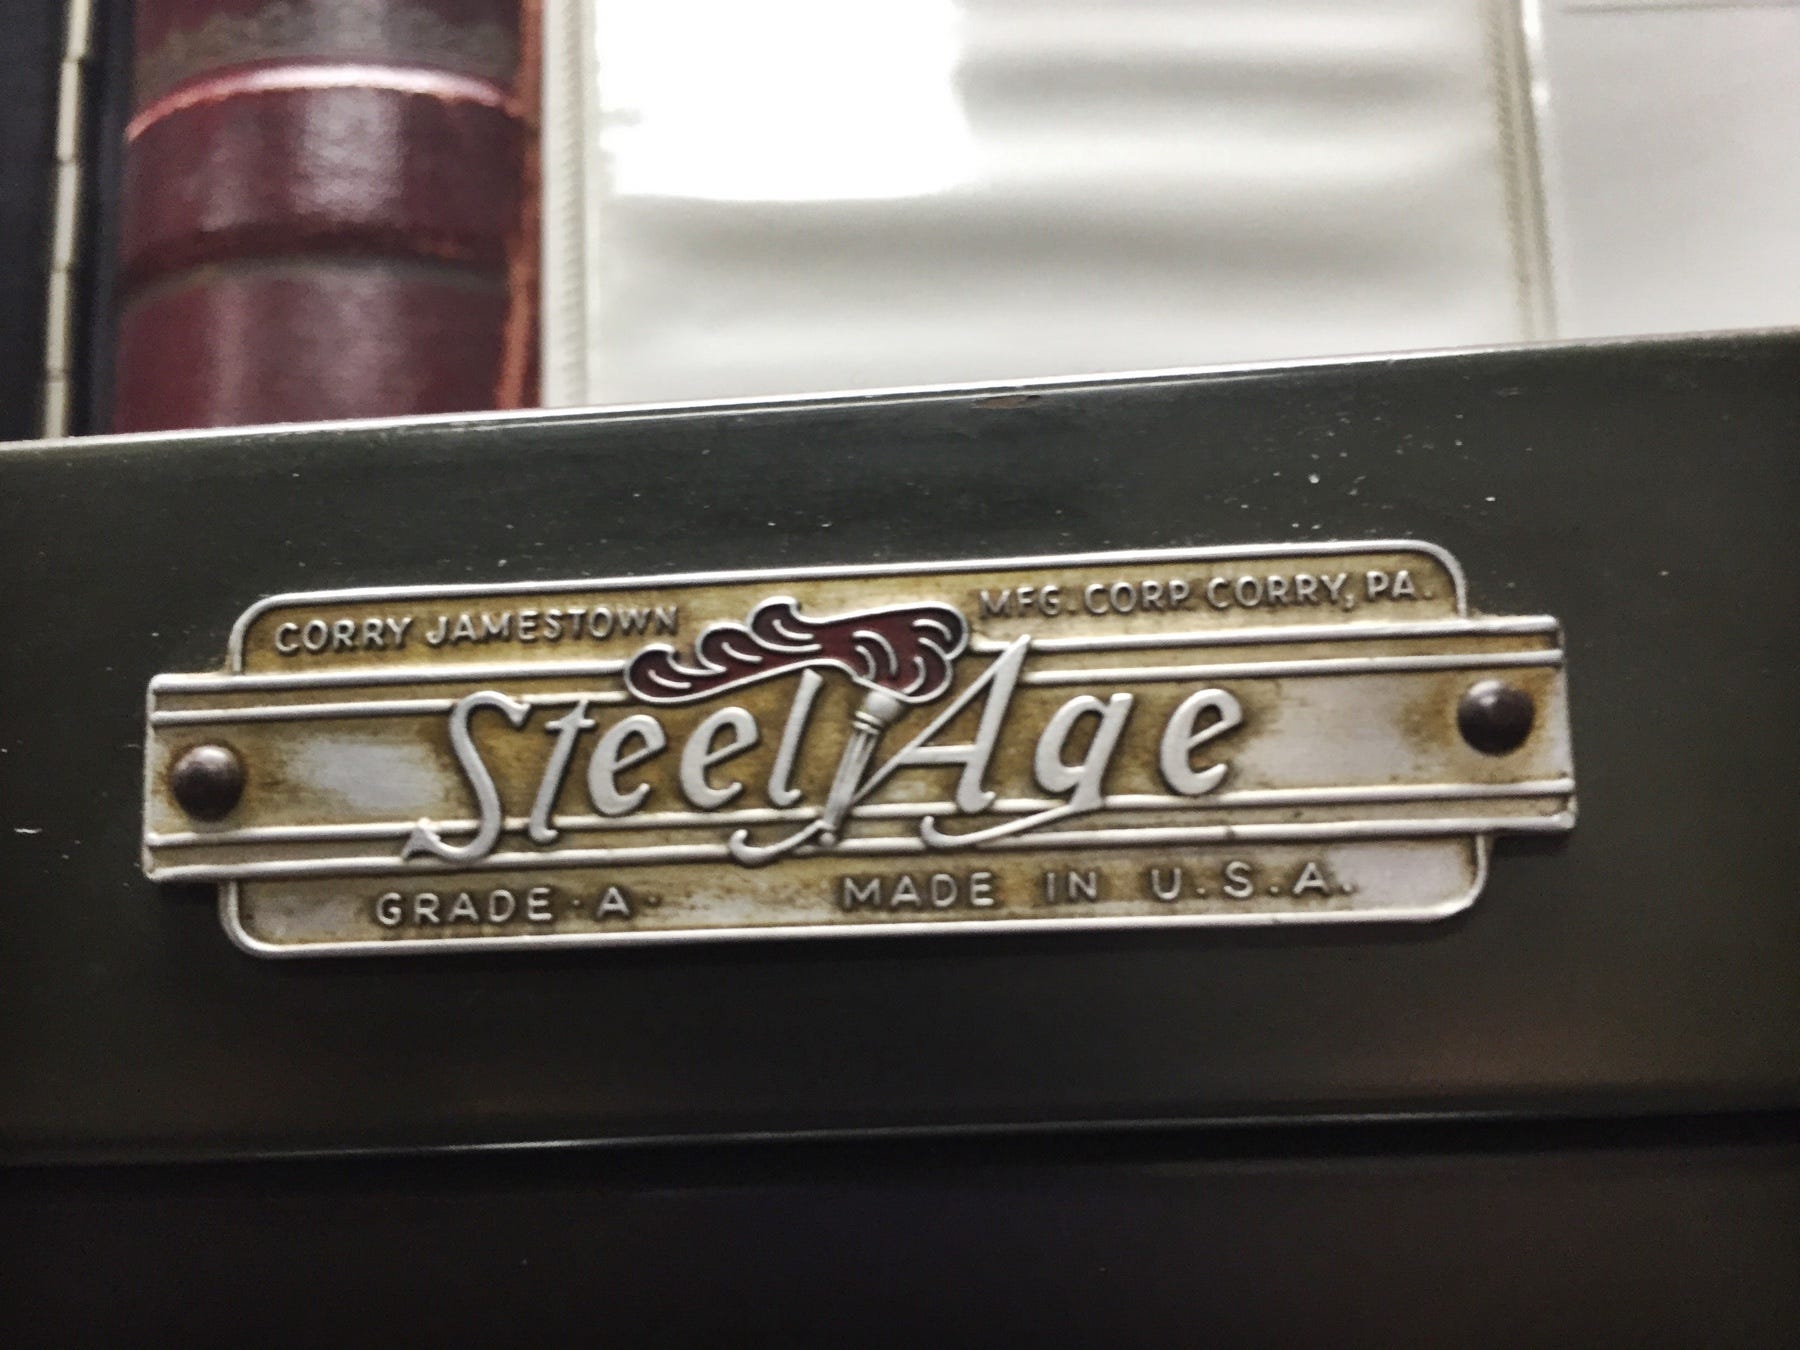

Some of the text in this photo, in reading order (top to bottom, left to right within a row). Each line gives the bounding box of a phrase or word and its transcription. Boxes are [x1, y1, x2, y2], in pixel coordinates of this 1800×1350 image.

[274, 605, 679, 653] CORRY JAMESTOWN
[402, 633, 1244, 866] Steel Age
[375, 887, 554, 926] GRADE
[842, 871, 996, 909] MADE
[1043, 870, 1098, 901] IN
